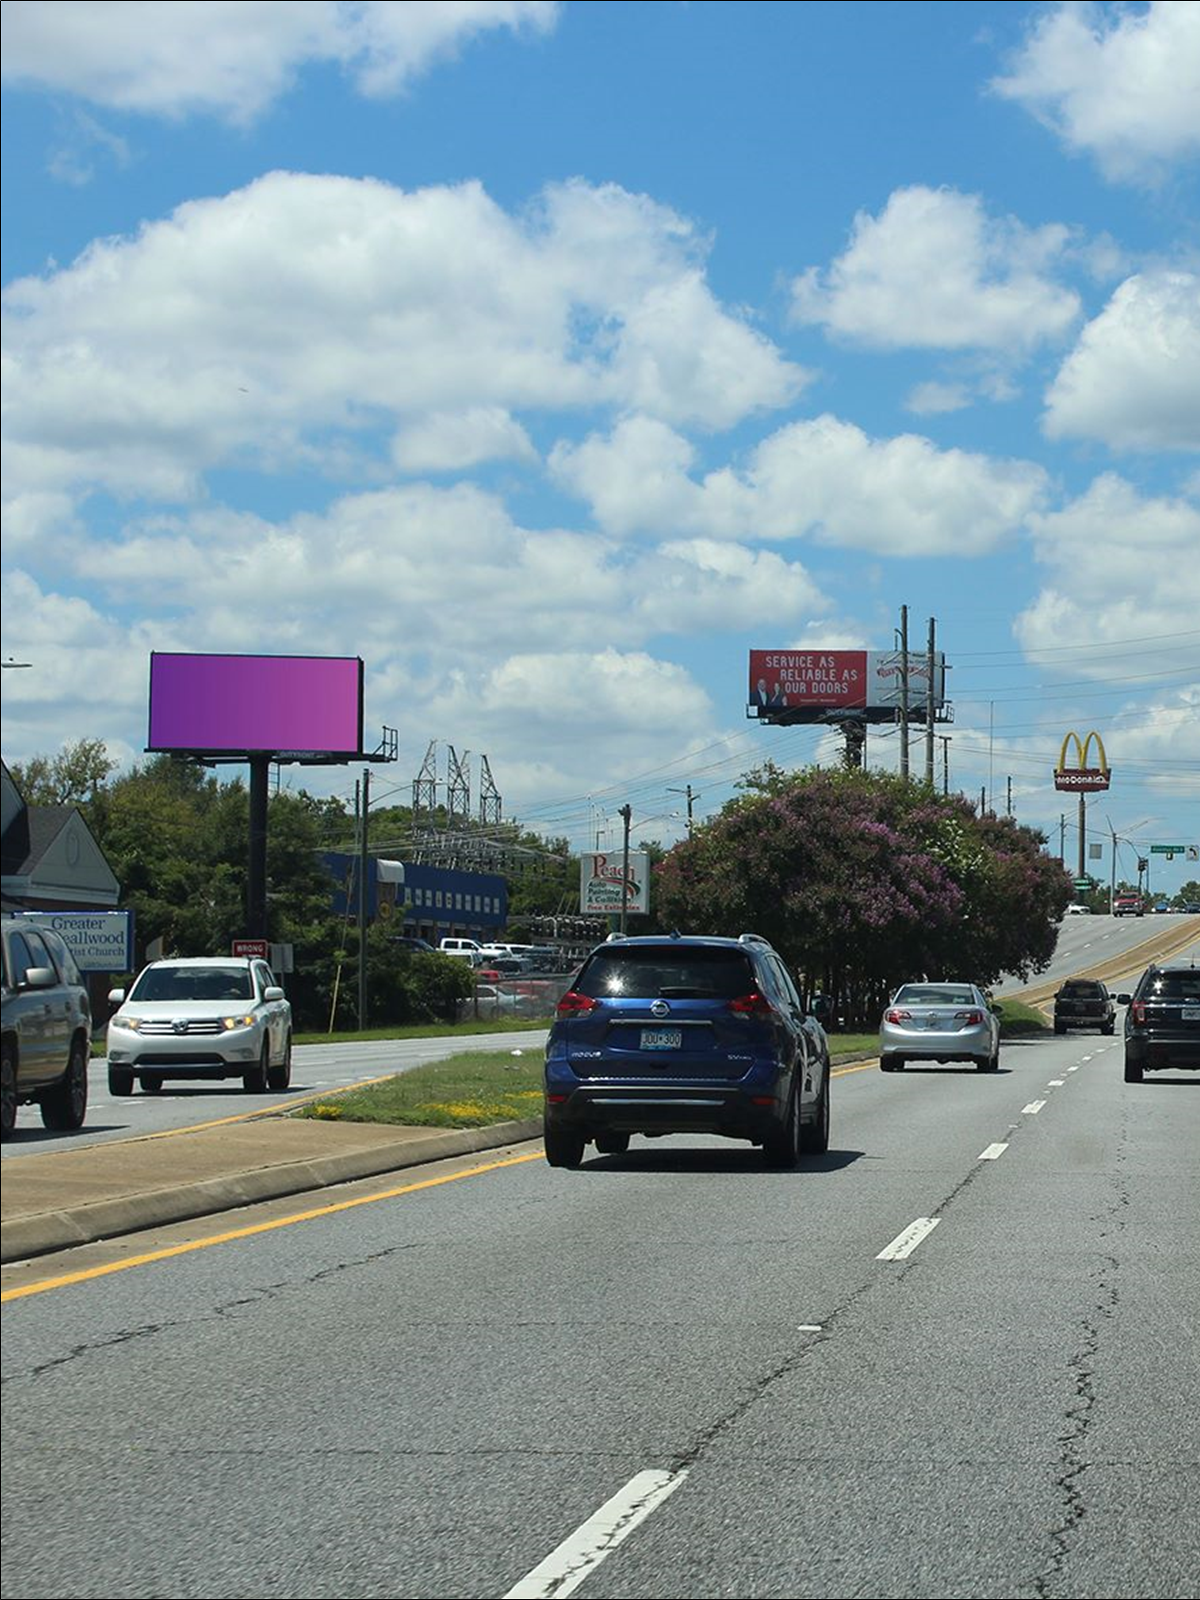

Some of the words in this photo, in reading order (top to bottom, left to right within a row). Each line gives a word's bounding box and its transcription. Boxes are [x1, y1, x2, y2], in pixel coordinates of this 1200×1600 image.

[766, 656, 813, 668] SERVICE
[819, 656, 835, 668] AS
[780, 669, 836, 681] RELIABLE
[842, 669, 857, 681] AS
[785, 682, 806, 694] OUR
[812, 682, 848, 694] DOORS
[51, 917, 106, 930] Greater
[61, 931, 125, 944] eallwood
[88, 947, 125, 957] Church
[237, 944, 264, 952] WRONG
